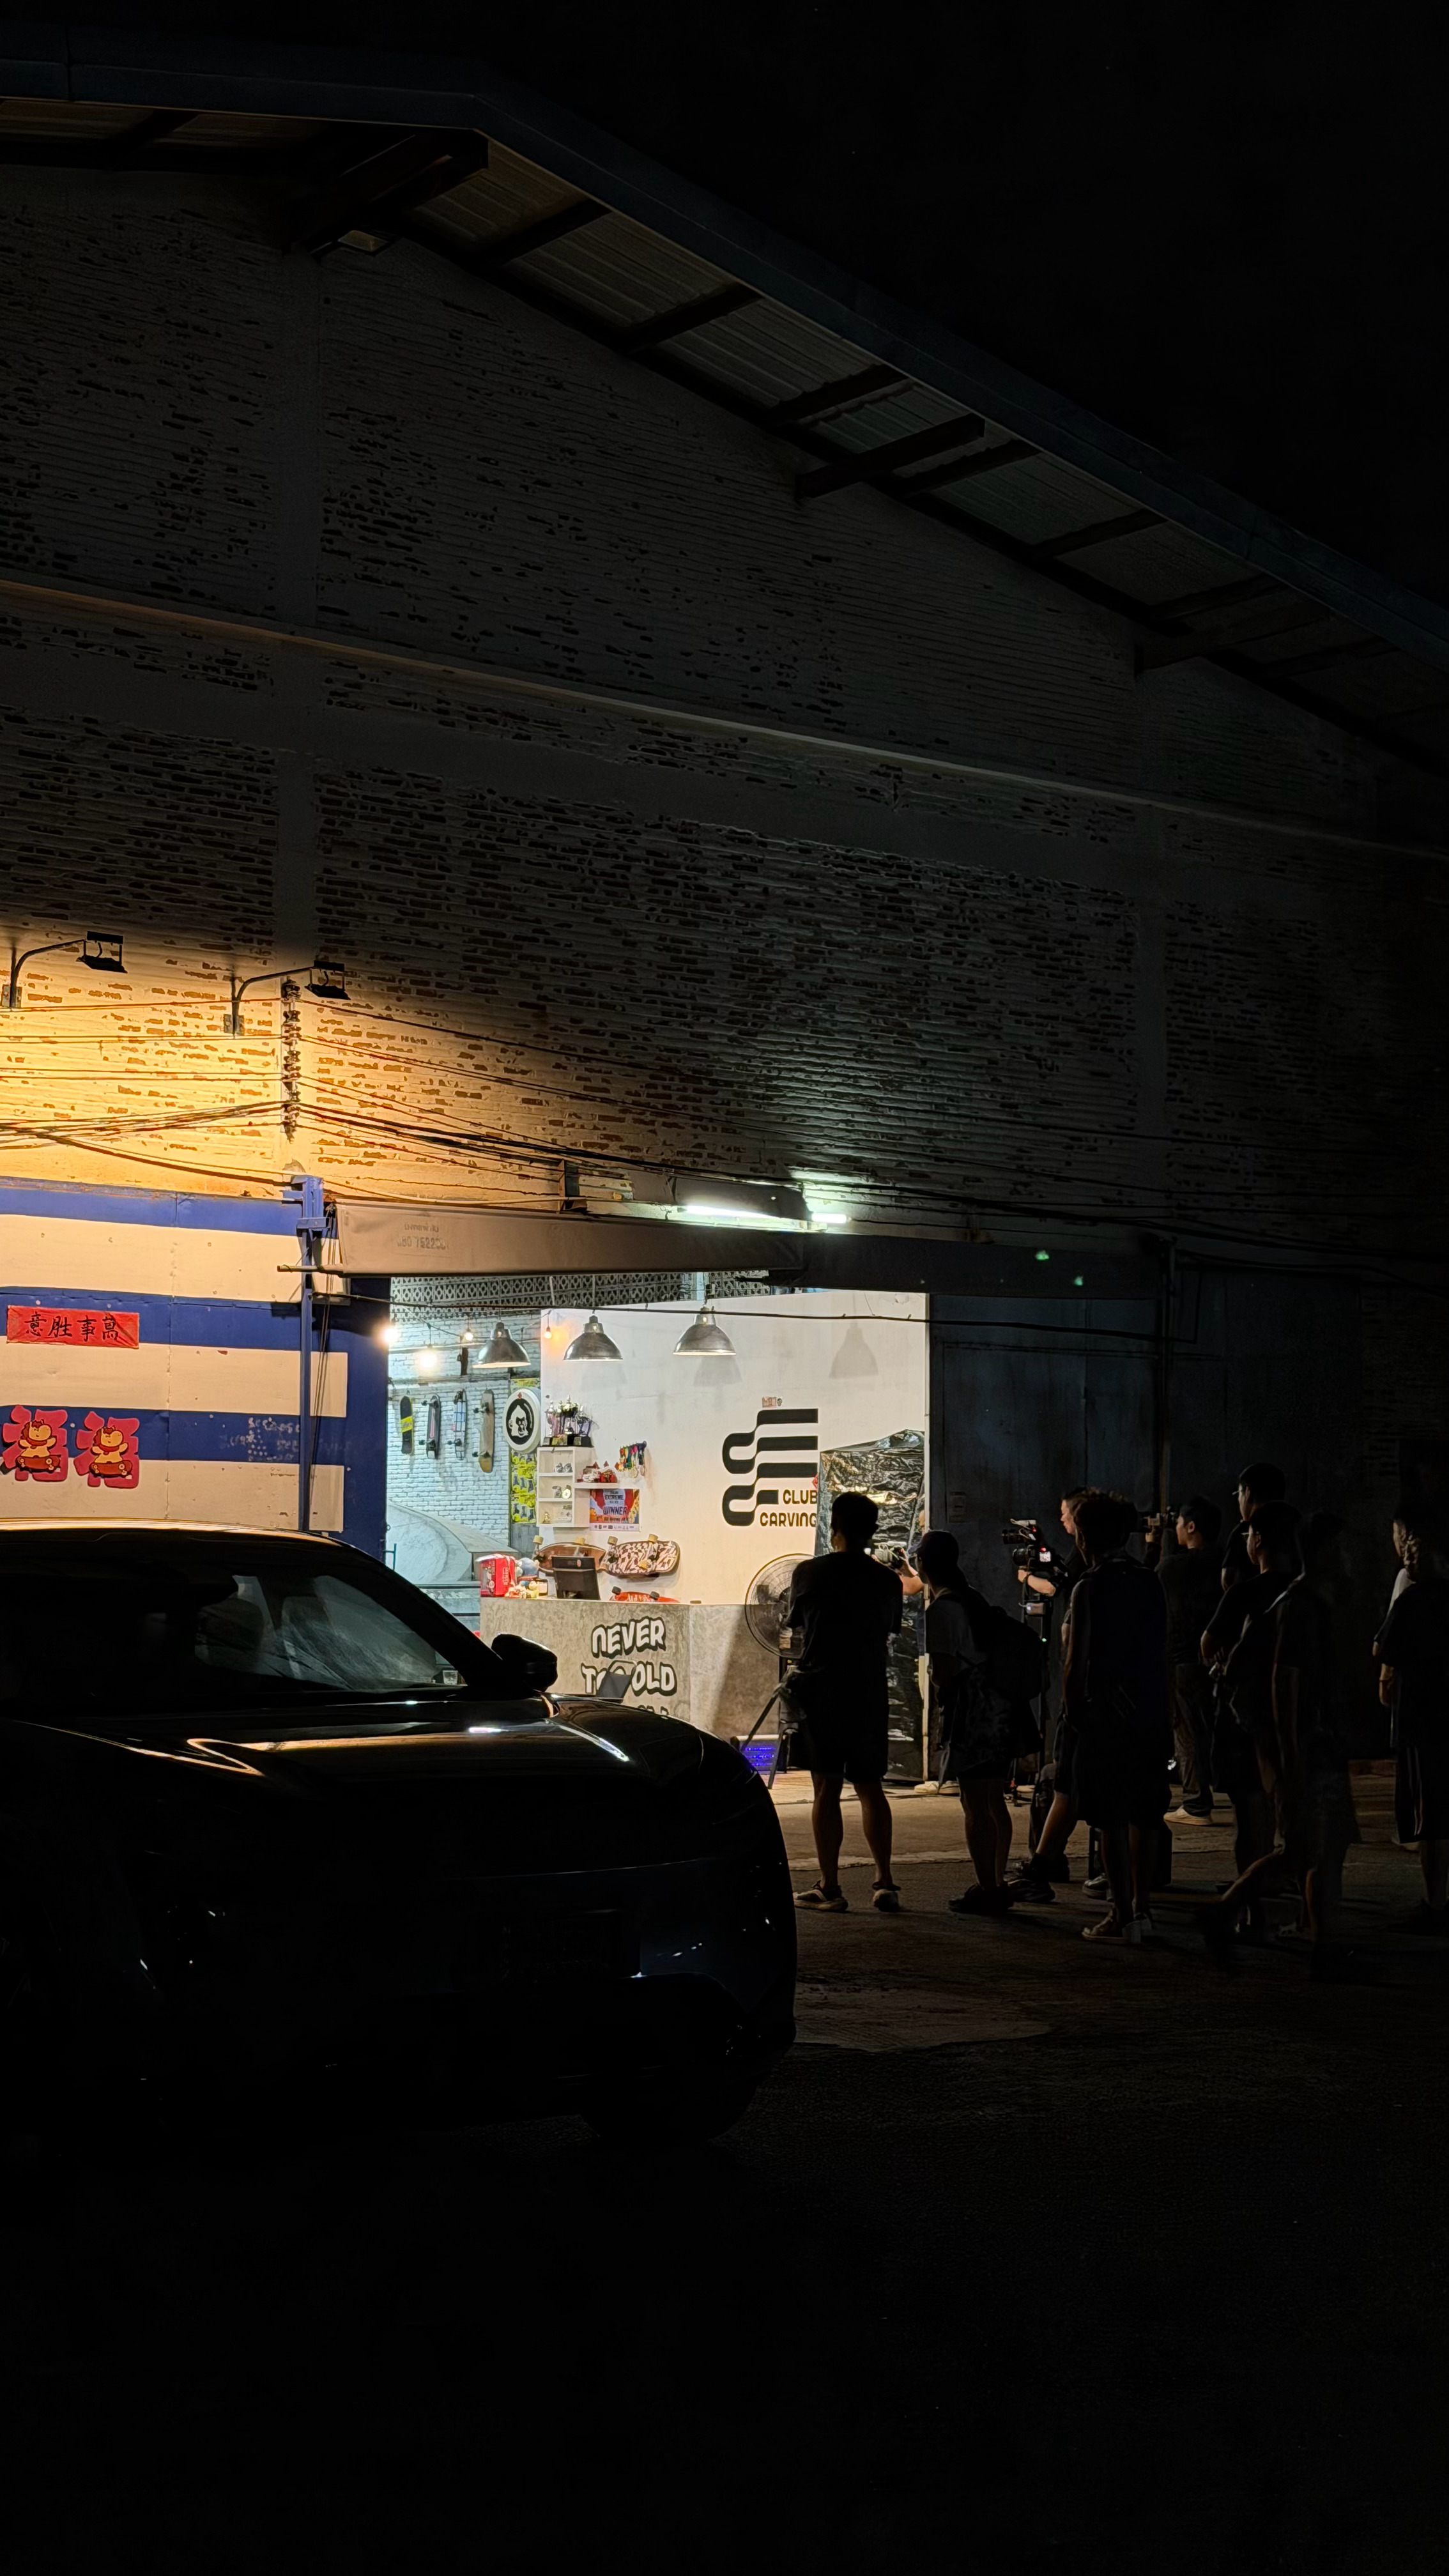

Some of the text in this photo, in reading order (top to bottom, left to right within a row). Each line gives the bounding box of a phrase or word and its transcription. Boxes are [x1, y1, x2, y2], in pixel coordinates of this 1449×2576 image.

[783, 1489, 817, 1505] CLUB
[603, 1506, 627, 1515] WINNER
[760, 1512, 816, 1527] CARVING
[591, 1616, 666, 1659] NEVER
[631, 1660, 678, 1697] OLD
